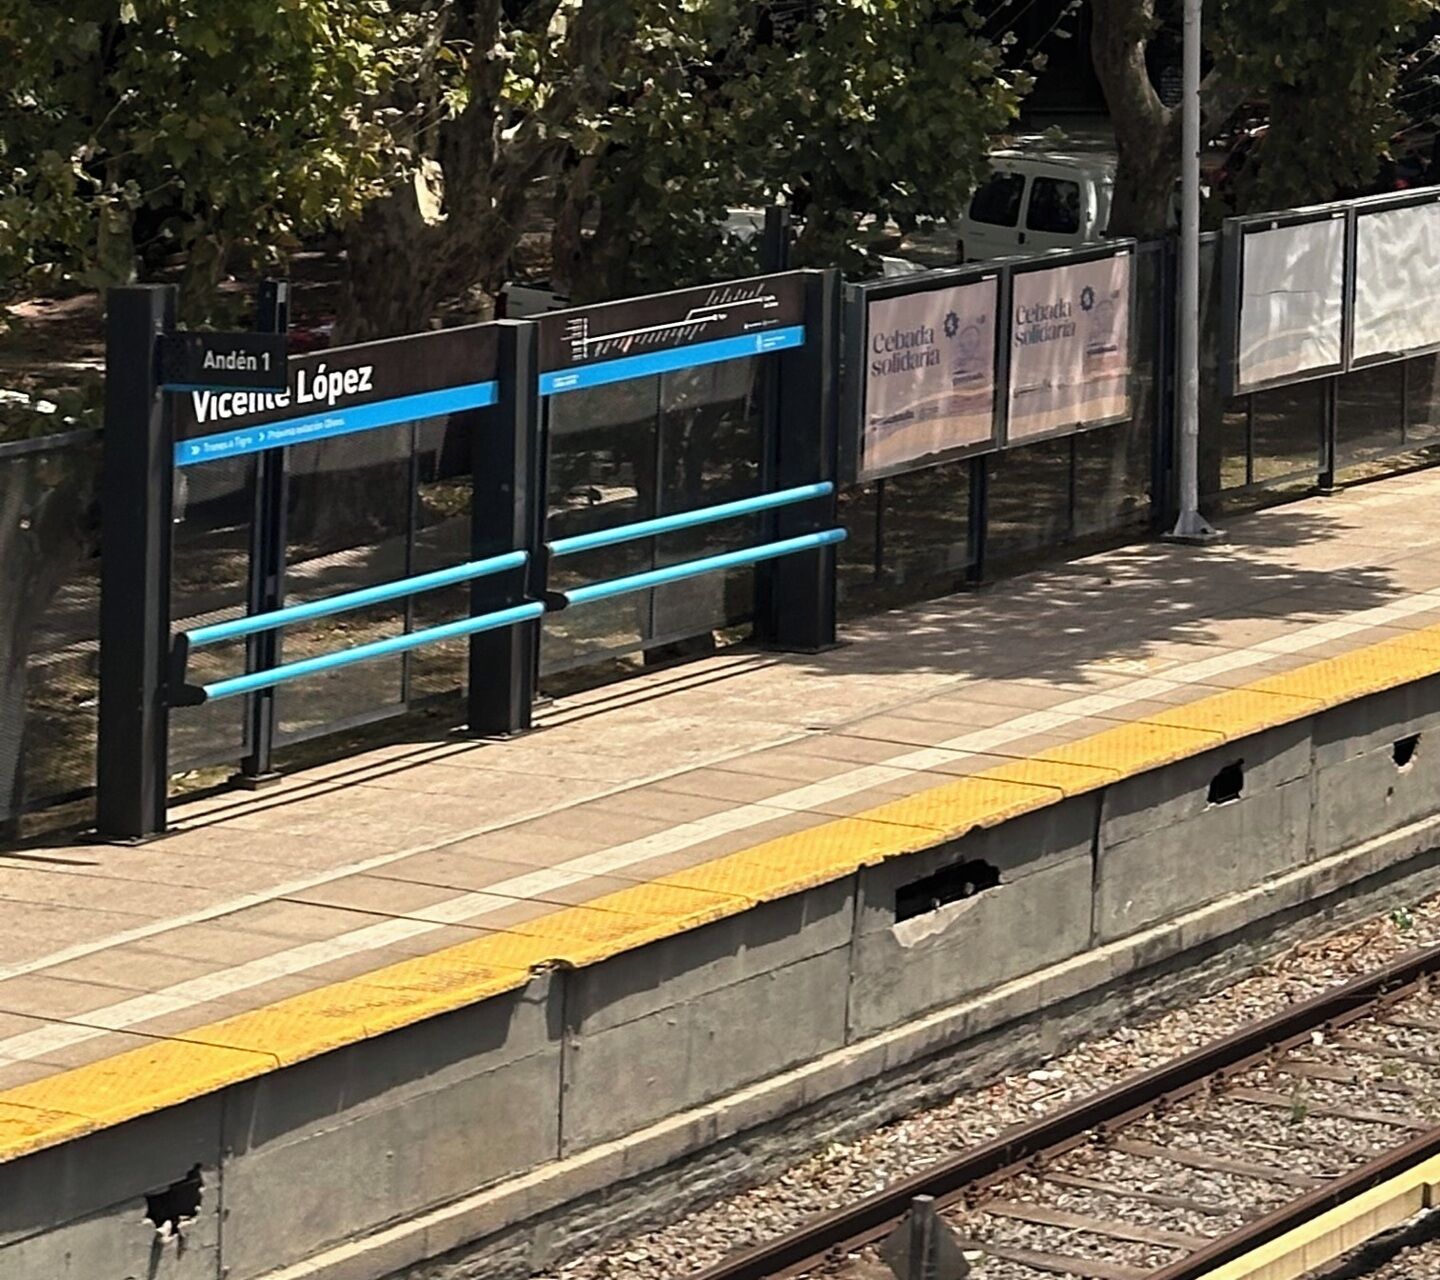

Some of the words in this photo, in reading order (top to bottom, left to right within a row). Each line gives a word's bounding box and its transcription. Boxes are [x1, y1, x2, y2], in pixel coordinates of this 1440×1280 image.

[1016, 298, 1071, 325] Cebada
[873, 325, 934, 354] Cebada
[1015, 320, 1076, 347] solidaria
[203, 349, 257, 371] Andén
[262, 352, 270, 371] 1
[871, 345, 940, 377] solidaria
[297, 364, 373, 406] López
